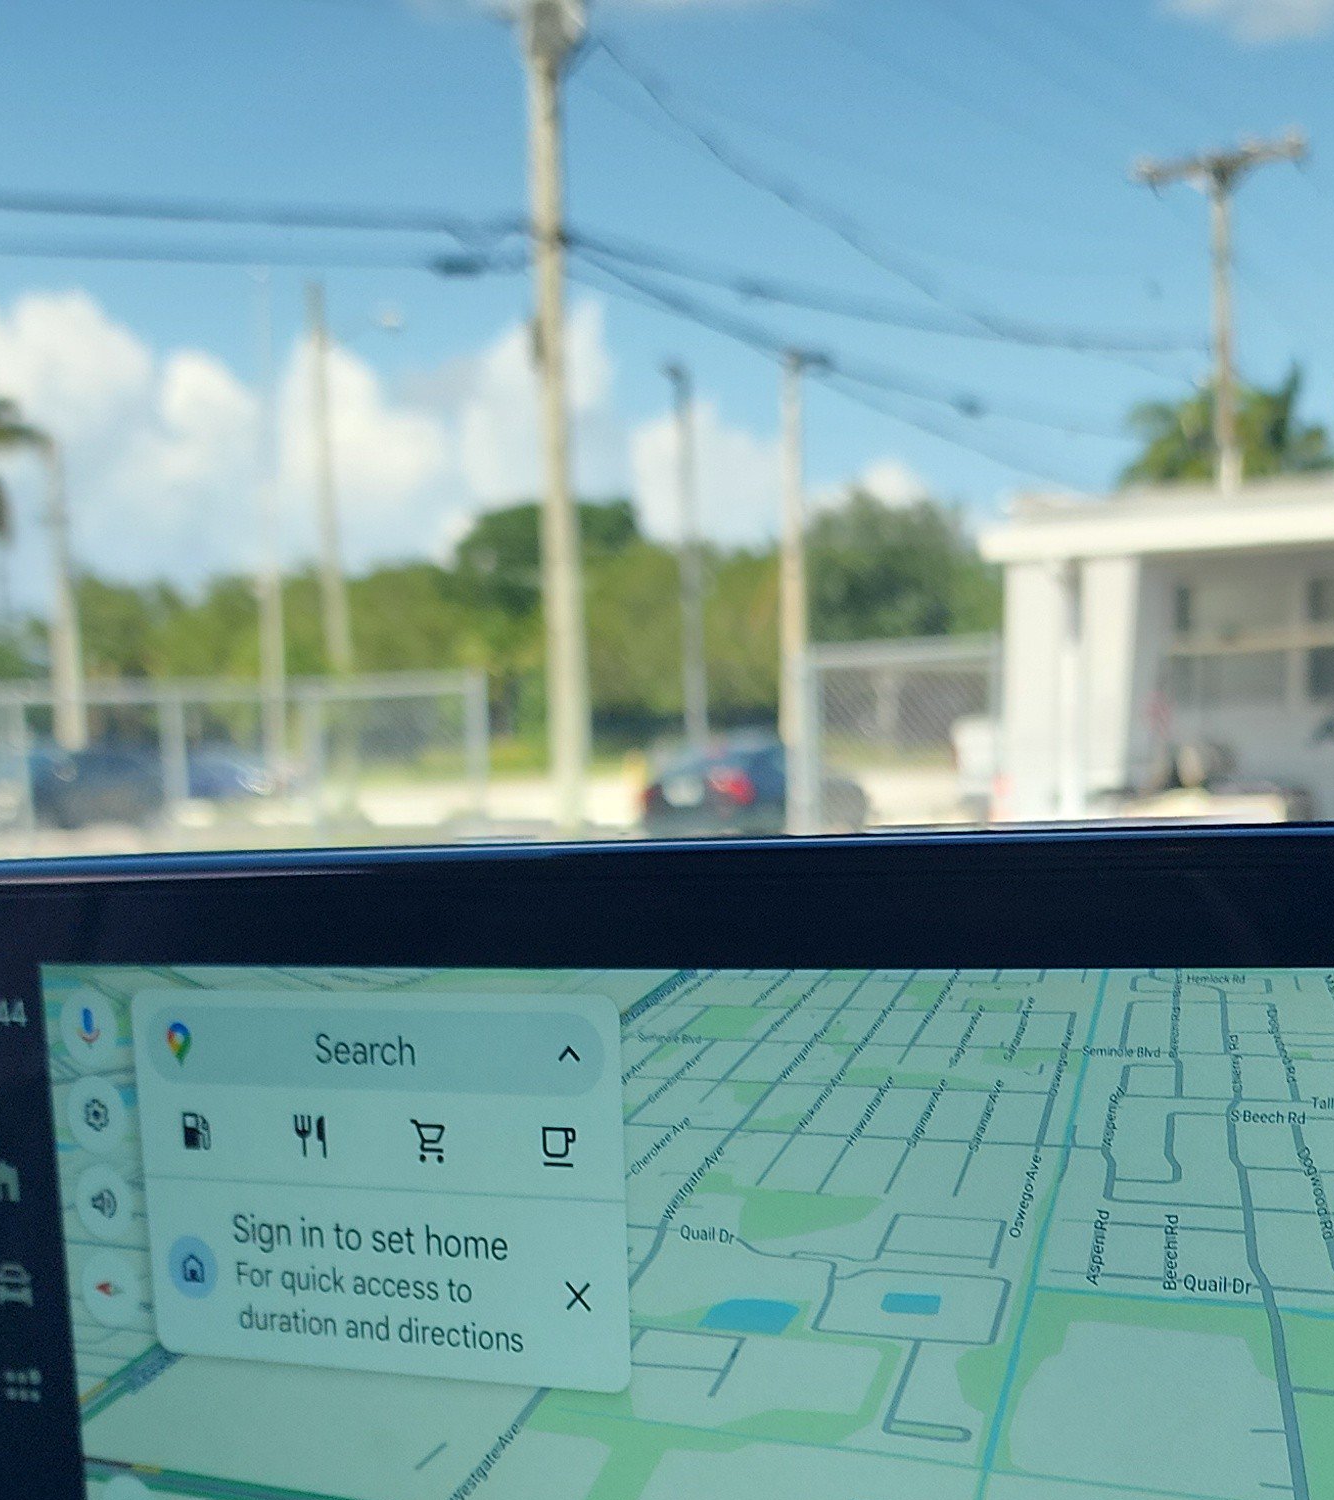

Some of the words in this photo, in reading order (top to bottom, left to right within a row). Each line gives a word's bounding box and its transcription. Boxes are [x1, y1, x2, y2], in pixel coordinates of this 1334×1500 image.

[1232, 975, 1245, 984] Rd
[316, 1034, 416, 1068] Search
[814, 1026, 829, 1043] Ave
[1082, 1045, 1134, 1058] Seminole
[1136, 1046, 1161, 1058] Blvd
[798, 1086, 833, 1129] Nokomis
[829, 1068, 847, 1088] Ave
[988, 1079, 1005, 1104] Ave
[1110, 1085, 1126, 1107] Rd
[845, 1093, 882, 1147] Hiawatha
[878, 1075, 895, 1098] Ave
[905, 1098, 937, 1149] Saginaw
[932, 1078, 949, 1102] Ave
[1230, 1110, 1240, 1122] S
[1243, 1110, 1284, 1124] Beech
[1288, 1111, 1306, 1125] Rd
[629, 1132, 673, 1177] Cherokee
[671, 1116, 691, 1136] Ave
[662, 1165, 708, 1222] Westgate
[703, 1145, 725, 1171] Ave
[1009, 1180, 1034, 1239] Oswego
[1025, 1153, 1043, 1182] Ave
[1297, 1146, 1331, 1218] Dogwood
[232, 1214, 291, 1256] Sign
[300, 1220, 325, 1251] in
[334, 1223, 362, 1254] to
[371, 1227, 416, 1259] set
[425, 1228, 509, 1263] home
[680, 1224, 715, 1241] Quail
[719, 1228, 735, 1244] Dr
[1093, 1209, 1110, 1232] Rd
[1165, 1214, 1179, 1236] Rd
[1085, 1230, 1106, 1286] Aspen
[1163, 1239, 1179, 1291] Beech
[236, 1262, 272, 1291] For
[280, 1265, 345, 1298] quick
[353, 1277, 439, 1303] access
[447, 1279, 473, 1305] to
[1183, 1273, 1228, 1293] Quail
[1231, 1276, 1252, 1294] Dr
[238, 1305, 337, 1340] duration
[345, 1312, 390, 1344] and
[398, 1316, 524, 1355] directions
[498, 1423, 520, 1451] Ave
